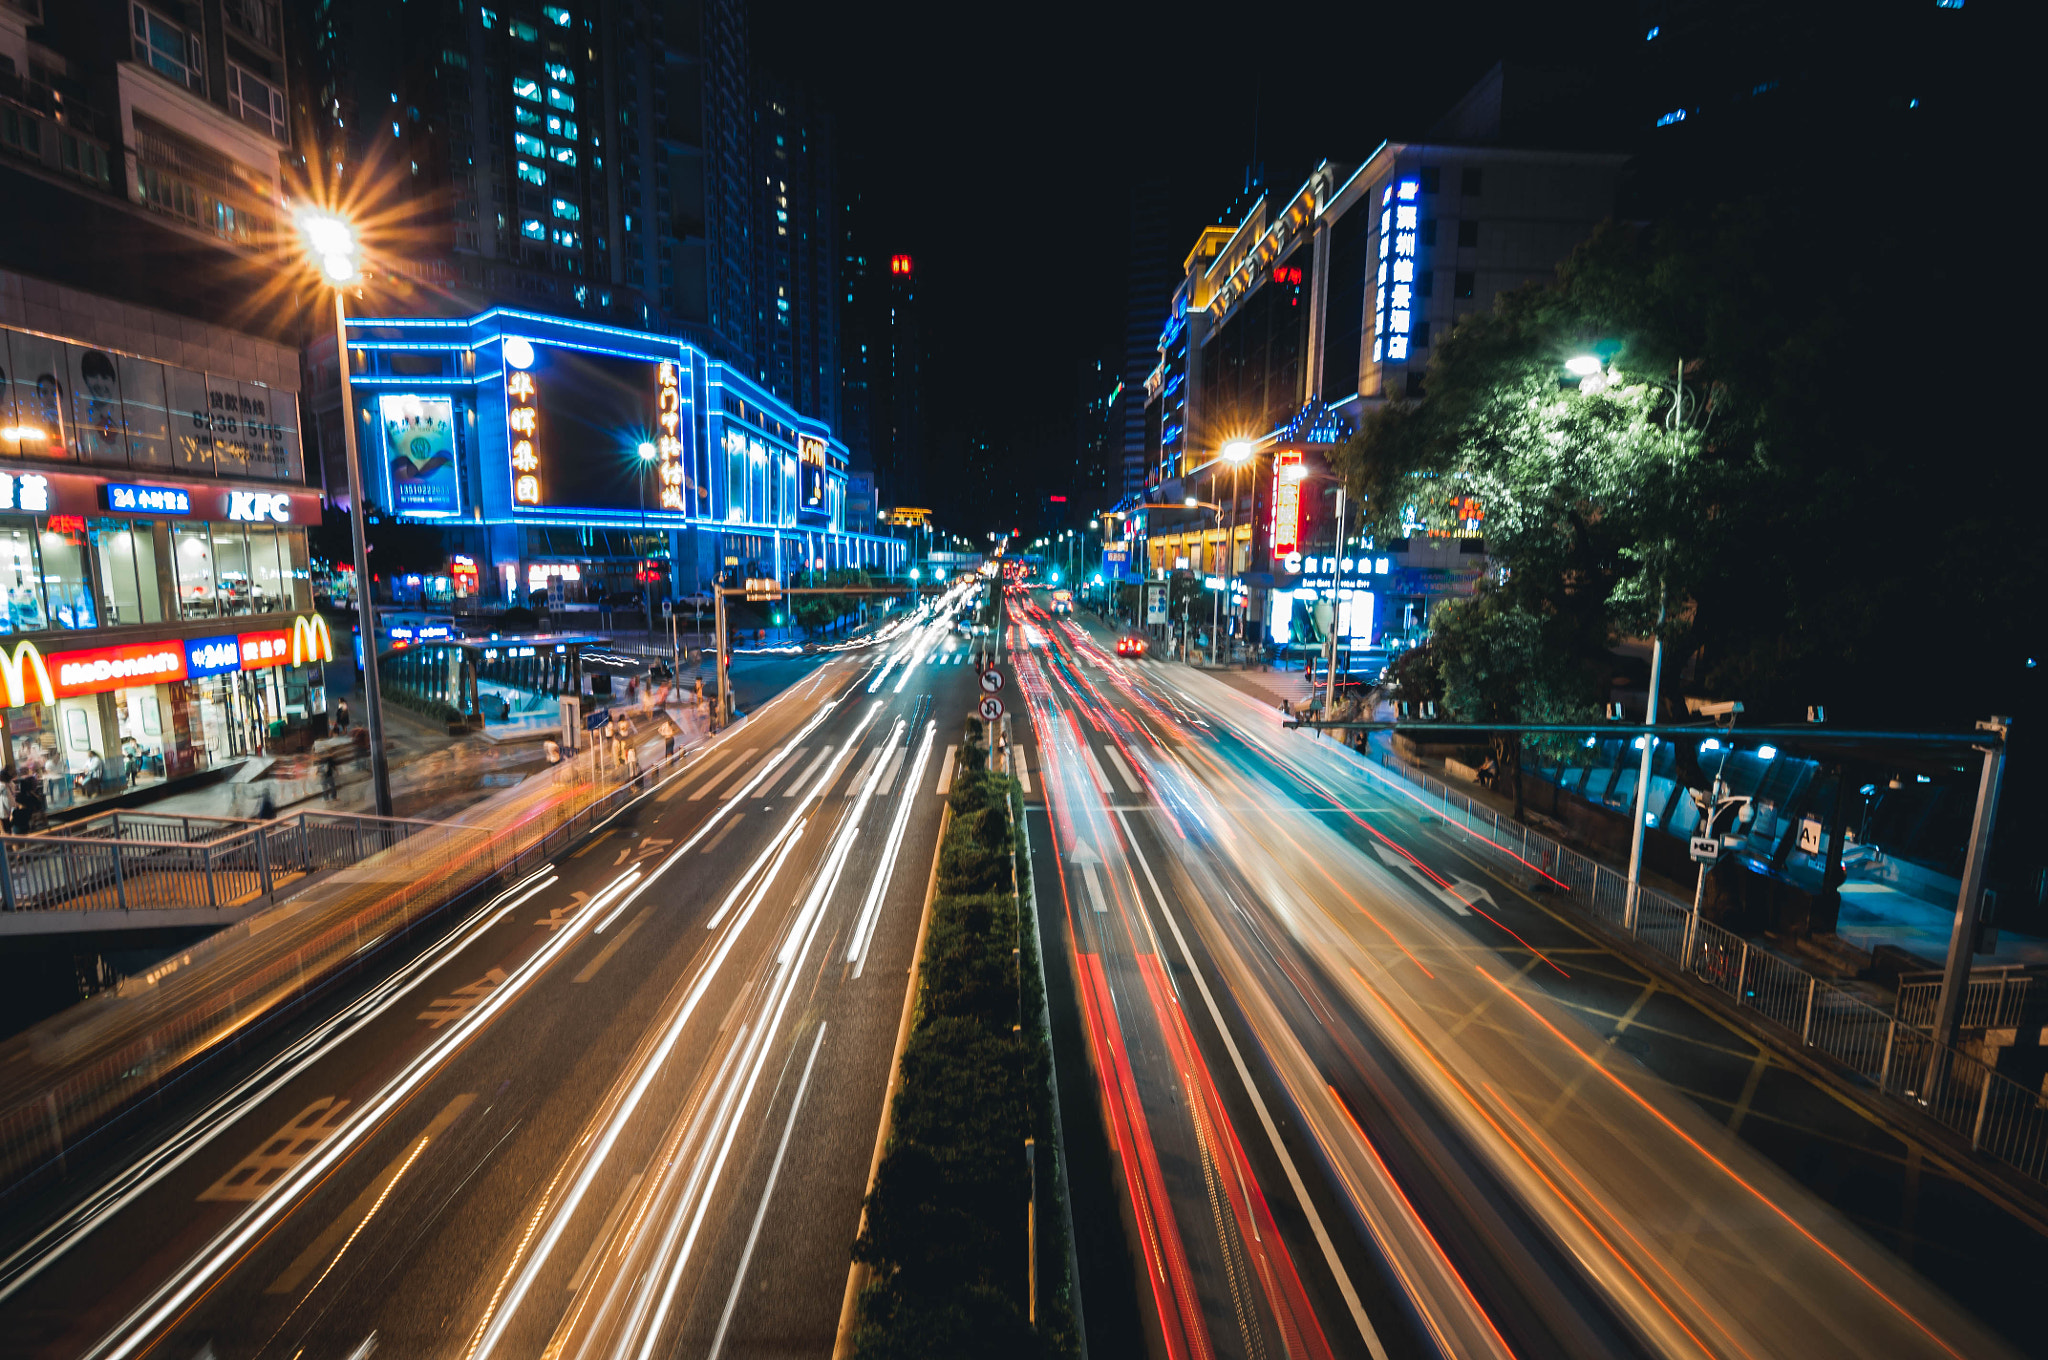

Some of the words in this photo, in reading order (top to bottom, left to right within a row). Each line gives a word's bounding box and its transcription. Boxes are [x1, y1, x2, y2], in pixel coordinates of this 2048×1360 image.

[192, 409, 238, 435] 8238
[230, 491, 290, 522] KFC
[60, 652, 180, 686] McDonald's
